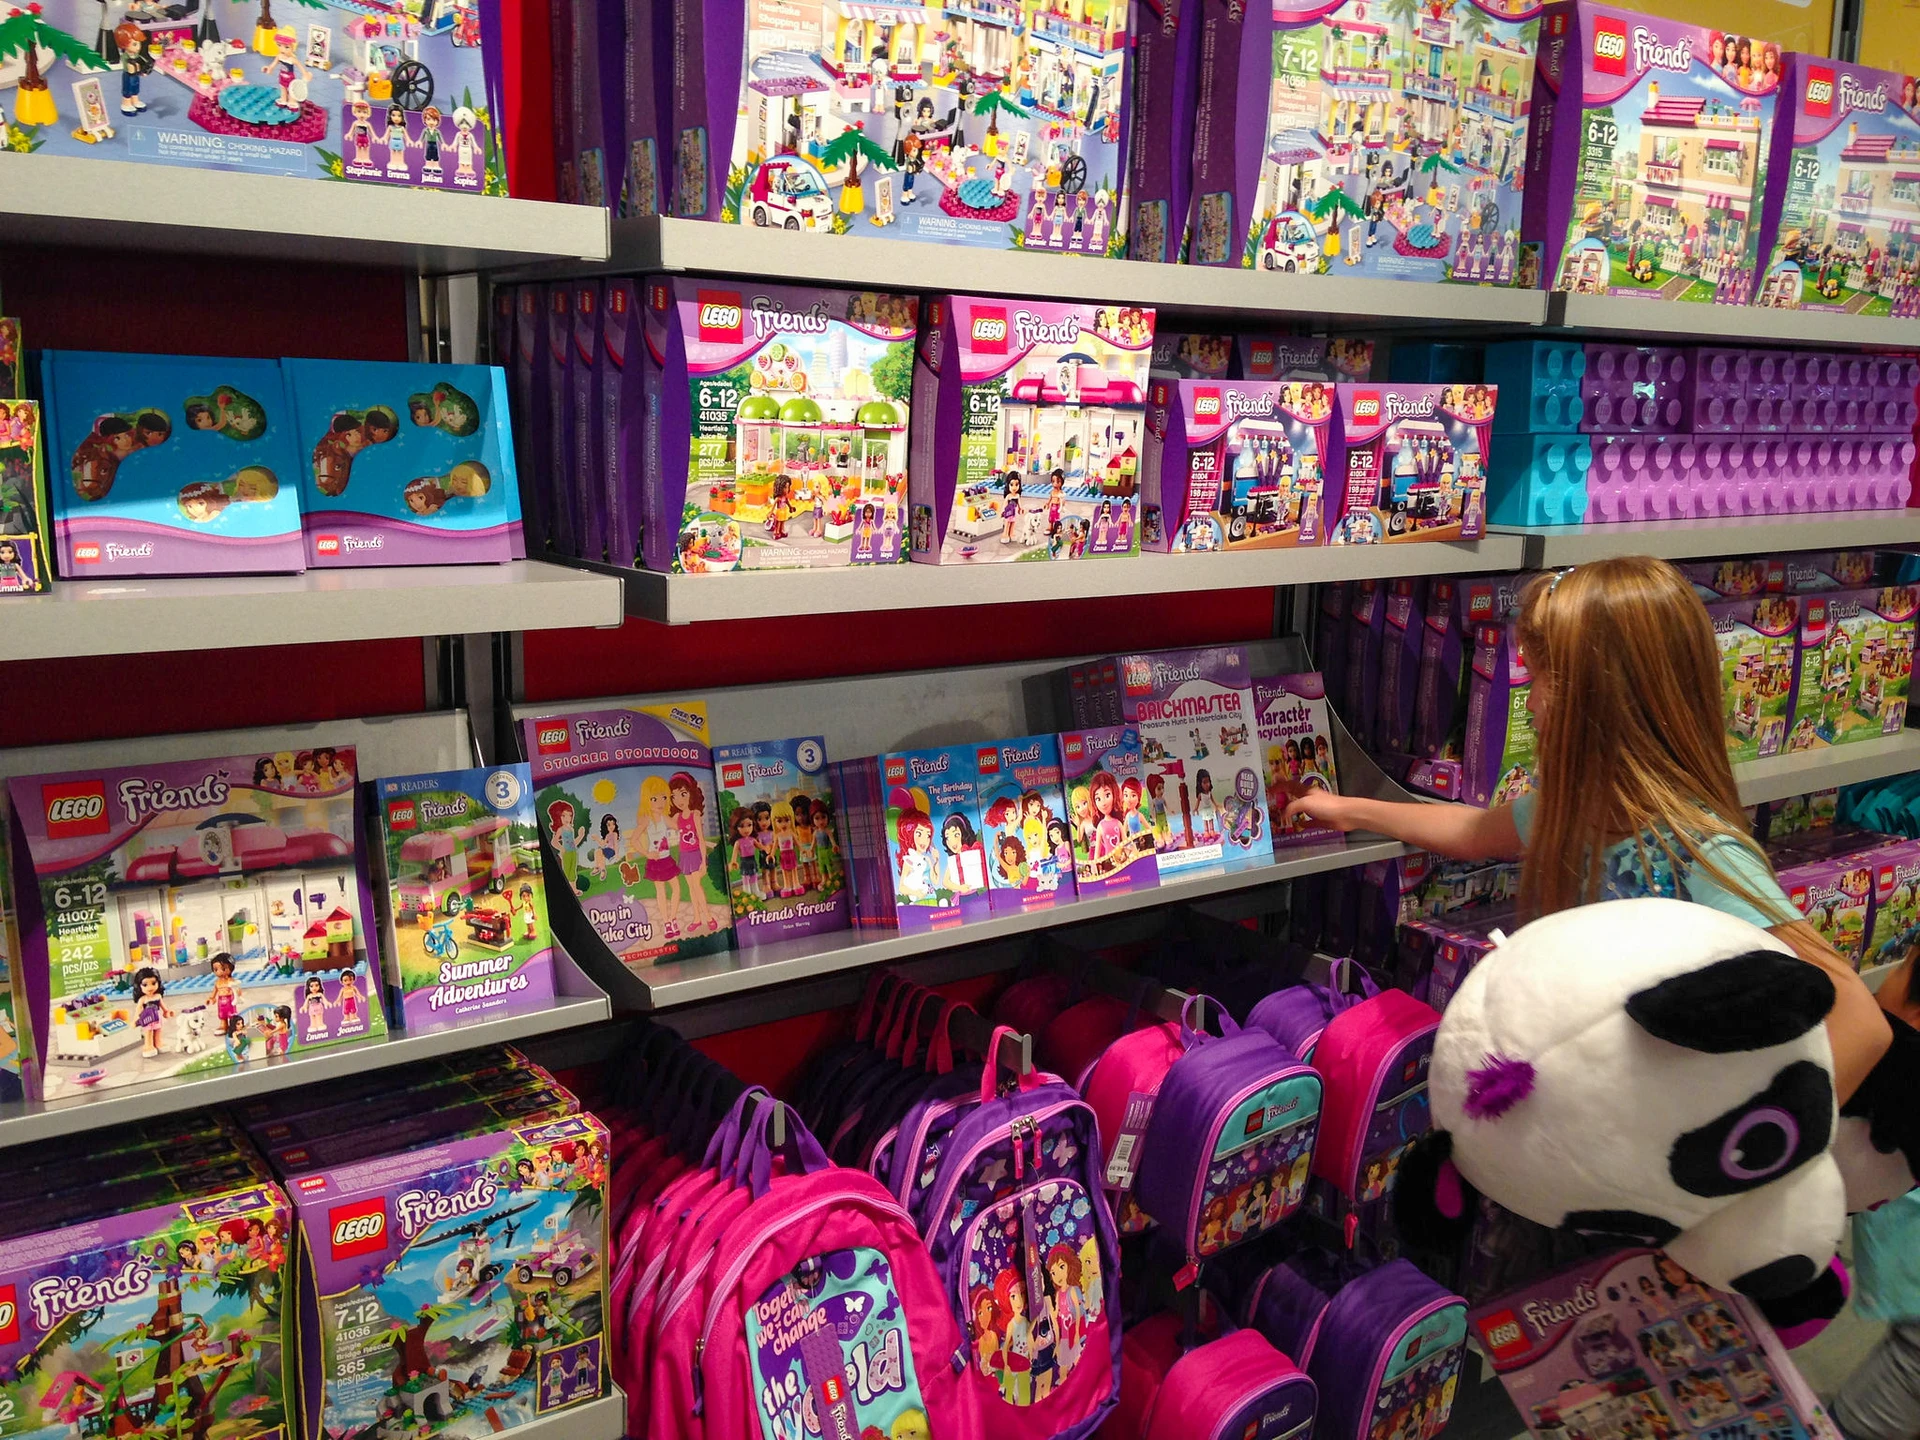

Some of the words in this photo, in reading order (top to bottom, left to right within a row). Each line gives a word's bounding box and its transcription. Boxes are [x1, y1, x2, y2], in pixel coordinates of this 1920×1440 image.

[758, 13, 800, 31] Shopping
[801, 20, 819, 31] Mall
[1553, 15, 1563, 34] LEGO
[1281, 44, 1319, 73] 7-12
[1549, 39, 1564, 77] Friends
[1596, 32, 1625, 59] LEGO
[1633, 26, 1692, 75] Friends
[1807, 80, 1832, 104] LEGO
[1839, 73, 1887, 117] Friends
[157, 132, 226, 149] WARNING:
[228, 142, 268, 154] CHOKING
[1588, 122, 1618, 146] 6-12
[1586, 145, 1604, 158] 3315
[346, 166, 382, 178] Stephanie
[387, 171, 410, 180] Emma
[421, 174, 443, 184] Julian
[453, 176, 478, 187] Sophie
[1200, 163, 1208, 180] City
[1795, 159, 1820, 180] 6-12
[701, 305, 740, 328] LEGO
[751, 296, 828, 341] Friends
[973, 319, 1006, 340] LEGO
[1014, 310, 1080, 351] Friends
[1252, 351, 1271, 363] LEGO
[1278, 345, 1319, 369] Friends
[699, 387, 738, 408] 6-12
[969, 394, 1001, 412] 6-12
[1195, 397, 1220, 415] LEGO
[1225, 389, 1274, 421] Friends
[1354, 397, 1379, 416] LEGO
[1385, 391, 1435, 422] Friends
[699, 411, 728, 421] 41035
[969, 415, 993, 425] 41007
[699, 443, 721, 456] 277
[967, 445, 988, 457] 242
[698, 456, 725, 469] pcs/pzs
[1192, 456, 1215, 470] 6-12
[1350, 455, 1373, 469] 6-12
[75, 547, 100, 559] LEGO
[106, 542, 151, 563] Friends
[318, 539, 339, 550] LEGO
[343, 534, 384, 555] Friends
[760, 547, 801, 557] WARNING:
[855, 552, 873, 560] Andrea
[1768, 571, 1783, 582] LEGO
[1787, 563, 1818, 585] Friends
[1472, 596, 1491, 610] LEGO
[1808, 608, 1824, 621] LEGO
[1828, 599, 1861, 625] Friends
[1804, 655, 1821, 668] 6-12
[1127, 672, 1150, 686] LEGO
[1153, 661, 1200, 690] Friends
[1256, 685, 1286, 702] Friends
[1513, 695, 1528, 710] 6-1
[670, 708, 689, 718] OVER
[689, 713, 704, 725] 90
[1139, 720, 1170, 730] Treasure
[1171, 717, 1187, 727] Hunt
[1195, 713, 1227, 724] Heartlake
[1228, 711, 1243, 721] City
[1255, 707, 1311, 727] haracter
[539, 730, 567, 744] LEGO
[575, 717, 631, 747] Friends
[1257, 721, 1314, 741] ncyclopedia
[731, 747, 762, 757] READERS
[1066, 743, 1081, 753] LEGO
[1086, 733, 1118, 755] Friends
[543, 752, 609, 771] STICKER
[615, 747, 699, 760] STORYBOOK
[804, 748, 815, 763] 3
[979, 755, 997, 767] LEGO
[1002, 744, 1040, 769] Friends
[1108, 755, 1124, 766] New
[1124, 752, 1139, 766] Girl
[725, 771, 742, 781] LEGO
[747, 761, 783, 783] Friends
[887, 766, 904, 778] LEGO
[910, 755, 948, 780] Friends
[1118, 765, 1138, 776] Town
[401, 779, 439, 791] READERS
[495, 781, 510, 799] 3
[928, 785, 940, 794] The
[942, 782, 973, 794] Birthday
[49, 795, 103, 823] LEGO
[118, 774, 230, 826] Friends
[391, 809, 414, 822] LEGO
[420, 797, 466, 823] Friends
[936, 794, 966, 806] Surprise
[1880, 873, 1893, 884] LEGO
[1895, 863, 1919, 884] Friends
[54, 883, 107, 909] 6-12
[1791, 894, 1806, 905] LEGO
[1808, 883, 1836, 905] Friends
[748, 906, 795, 926] Friends
[795, 901, 837, 918] Forever
[1401, 899, 1419, 911] 6-12
[57, 908, 96, 924] 41007
[590, 908, 617, 926] Day
[618, 905, 632, 920] in
[58, 924, 99, 936] Heartlake
[59, 935, 74, 944] Pet
[75, 932, 100, 942] Salon
[598, 927, 624, 943] ake
[626, 922, 652, 940] City
[61, 945, 94, 962] 242
[625, 945, 677, 960] SCHOLASTIC
[62, 960, 99, 977] pcs/pzs
[439, 955, 513, 983] Summer
[428, 974, 529, 1011] Adventures
[455, 1003, 481, 1014] Catherine
[482, 999, 507, 1009] Saunders
[305, 1030, 329, 1042] Emma
[336, 1023, 364, 1038] Joanna
[300, 1177, 324, 1188] LEGO
[333, 1213, 385, 1245] LEGO
[396, 1175, 498, 1239] Friends
[29, 1258, 151, 1328] Friends
[752, 1279, 808, 1326] Togeth
[334, 1302, 380, 1330] 7-12
[756, 1322, 776, 1350] we
[783, 1297, 811, 1329] can
[1488, 1320, 1520, 1347] LEGO
[1522, 1283, 1598, 1337] Friends
[335, 1326, 371, 1342] 41036
[772, 1306, 829, 1357] change
[336, 1342, 362, 1354] Jungle
[336, 1350, 362, 1361] Bridge
[362, 1342, 391, 1354] Rescue
[337, 1358, 366, 1377] 365
[337, 1371, 370, 1390] pcs/pzs
[826, 1379, 839, 1400] LEGO
[567, 1386, 597, 1402] Matthew
[763, 1370, 799, 1417] the
[830, 1403, 853, 1440] Friend
[1262, 1403, 1291, 1428] Friends
